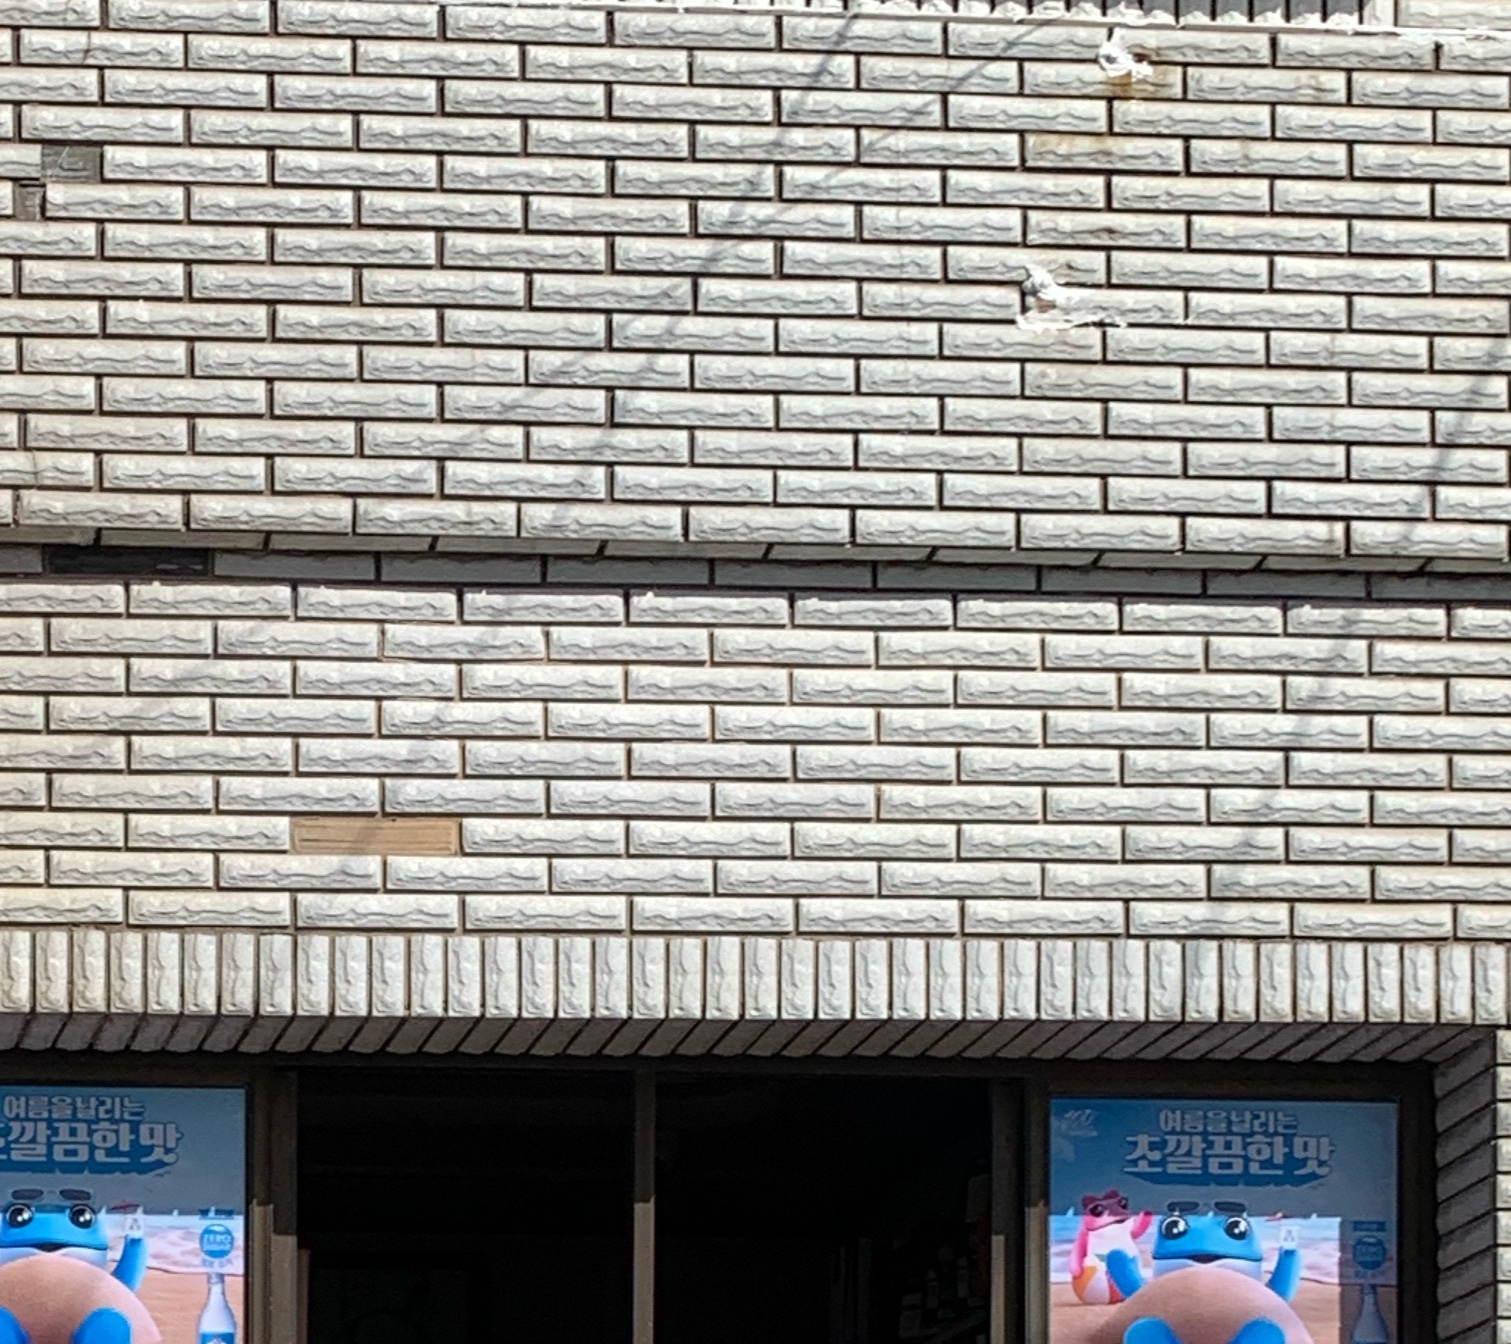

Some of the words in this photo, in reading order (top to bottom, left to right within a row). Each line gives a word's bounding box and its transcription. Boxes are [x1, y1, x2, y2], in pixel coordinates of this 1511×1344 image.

[139, 1123, 183, 1164] 맛
[1123, 1134, 1290, 1175] 초깔끔한
[1294, 1137, 1336, 1176] 맛
